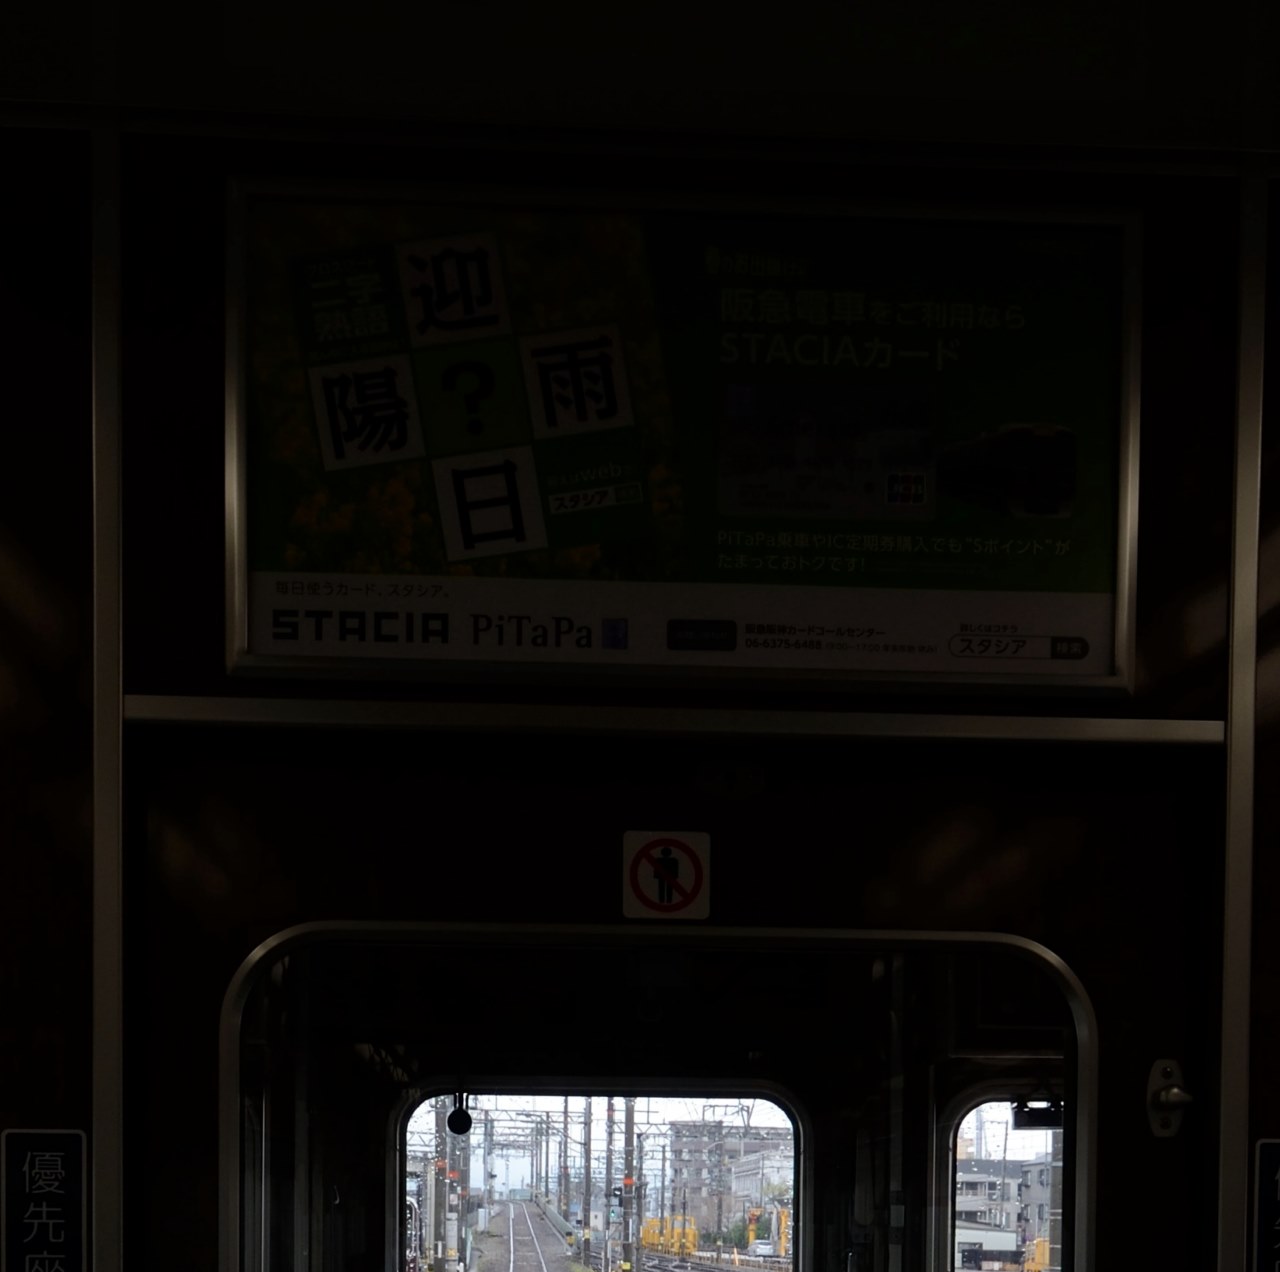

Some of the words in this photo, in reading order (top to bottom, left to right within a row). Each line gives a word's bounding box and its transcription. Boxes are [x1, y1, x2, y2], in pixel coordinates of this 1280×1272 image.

[405, 247, 499, 335] 迎
[719, 288, 1026, 330] 阪急電車をご利用なら
[719, 332, 961, 373] STACIAカード
[531, 336, 617, 427] 雨
[322, 367, 408, 458] 陽
[451, 460, 526, 549] 日
[272, 609, 450, 644] STACIA
[470, 613, 593, 650] PiTaPa
[745, 638, 822, 650] 06-6375-6488
[960, 638, 1027, 655] スタシア
